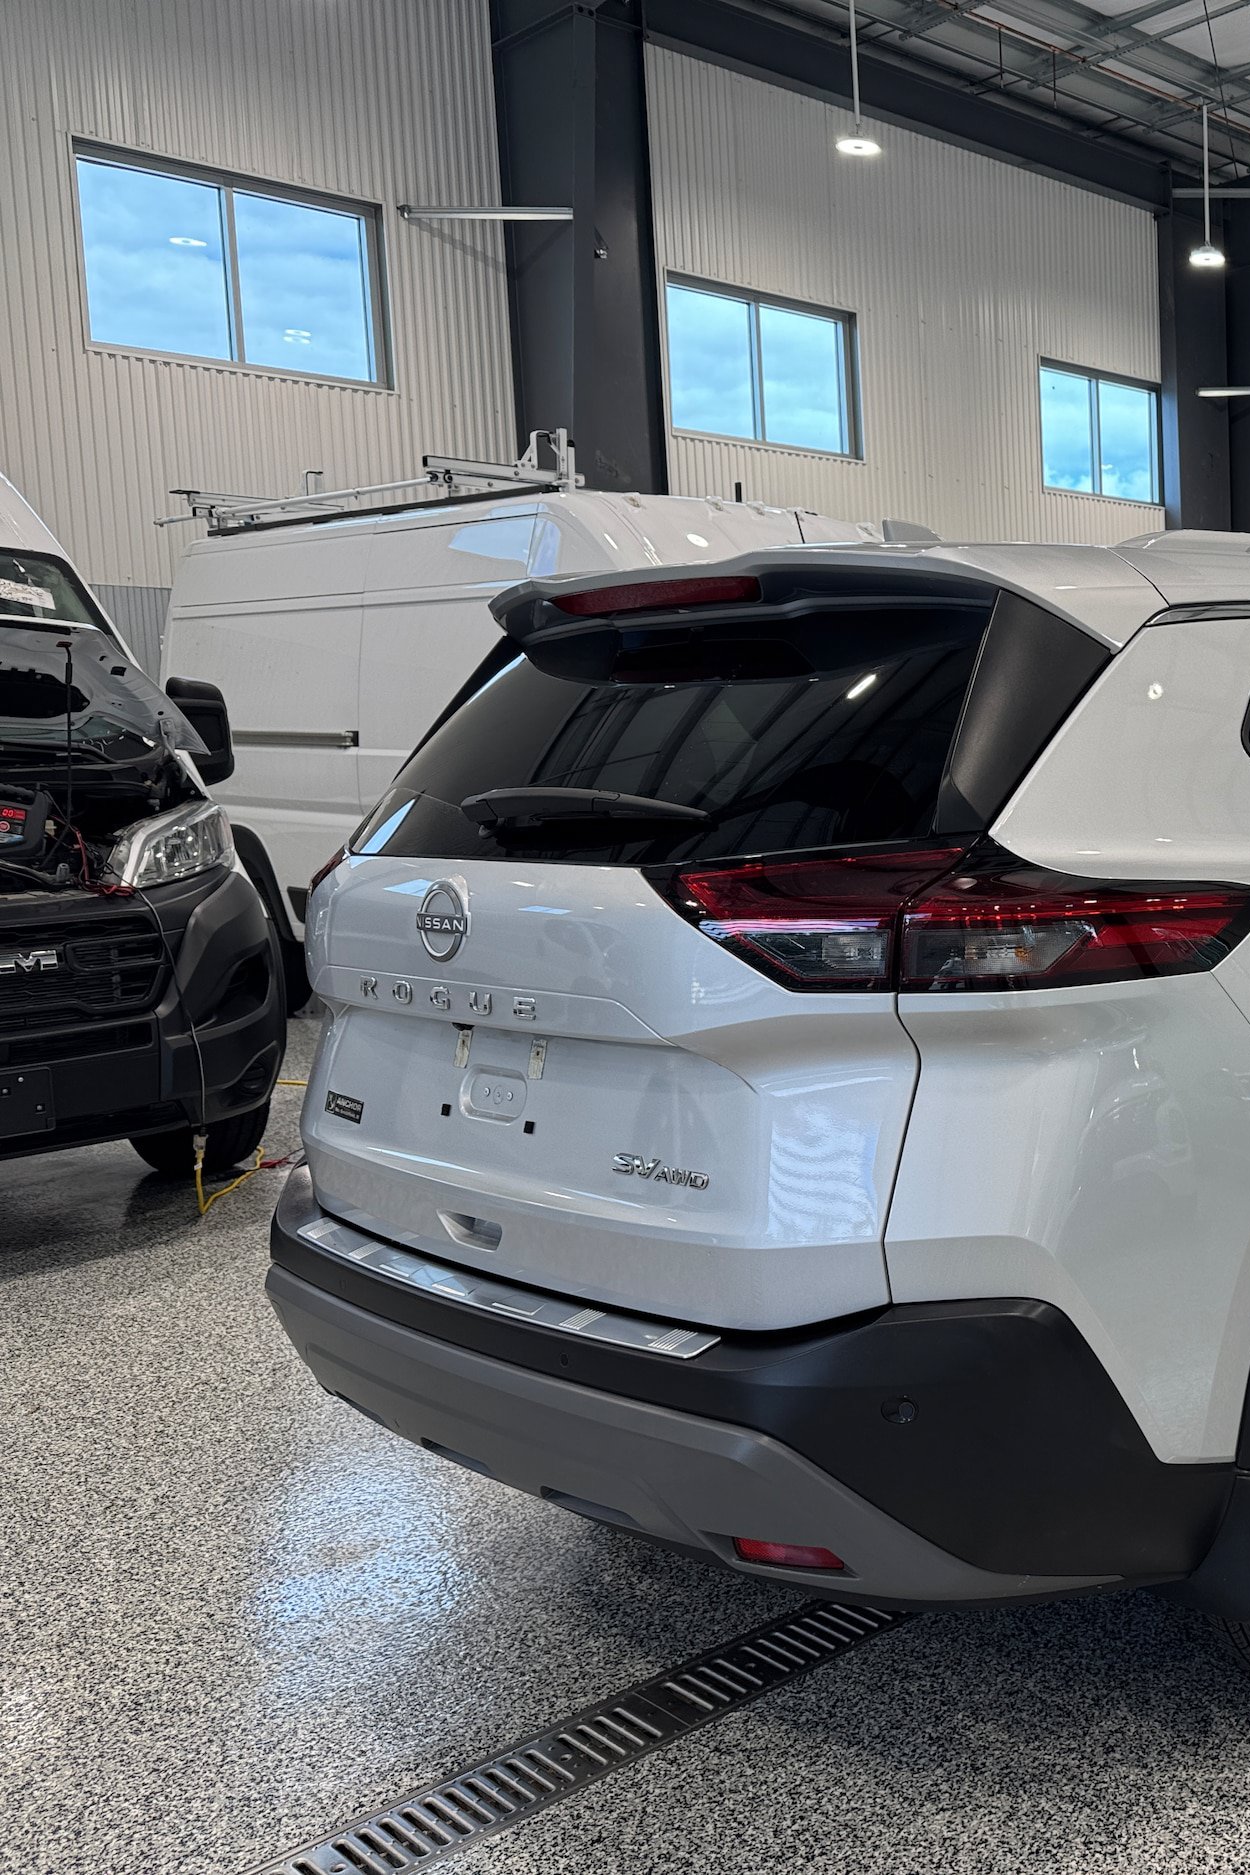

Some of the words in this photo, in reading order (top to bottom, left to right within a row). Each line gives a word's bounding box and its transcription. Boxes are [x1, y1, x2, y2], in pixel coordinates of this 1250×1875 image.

[417, 915, 464, 932] NISSAN
[360, 975, 537, 1021] ROGUE
[336, 1097, 363, 1112] ANCHOR
[611, 1152, 661, 1179] SV
[654, 1165, 709, 1190] AWD
